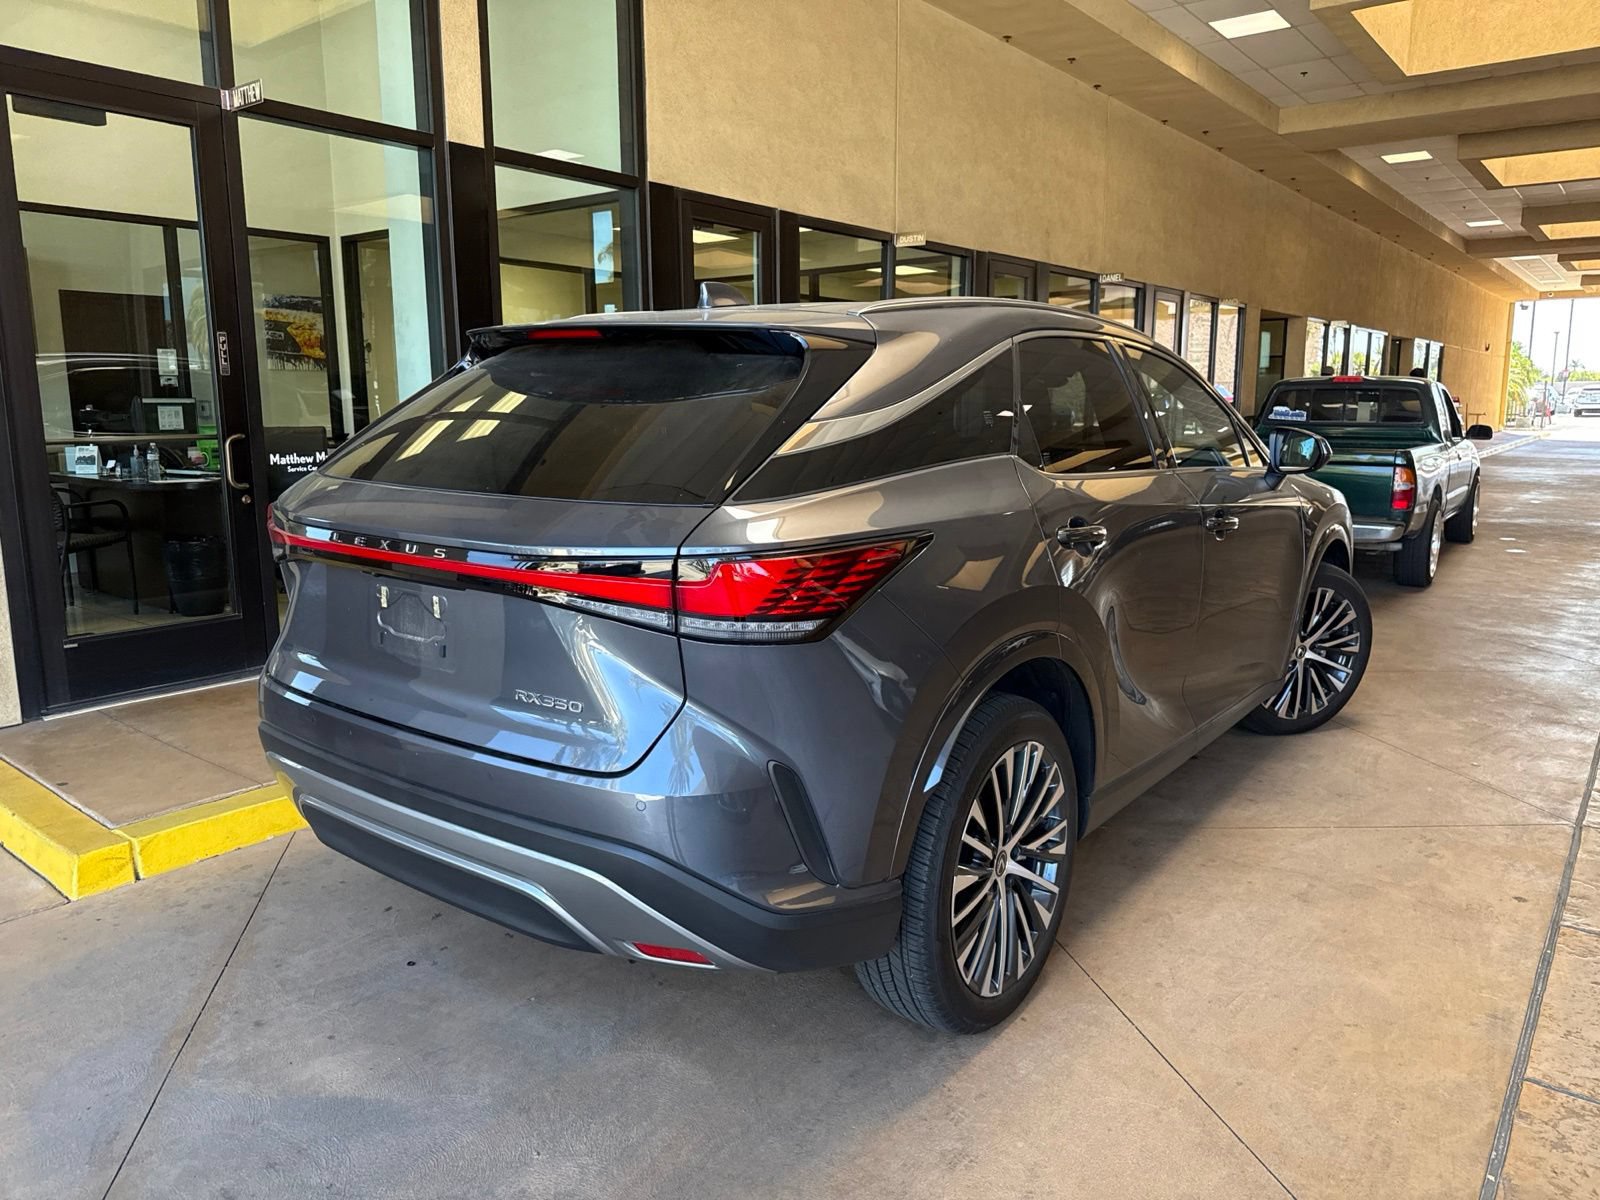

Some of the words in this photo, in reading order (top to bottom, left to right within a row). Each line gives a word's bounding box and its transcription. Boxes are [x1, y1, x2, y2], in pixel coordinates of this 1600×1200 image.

[233, 81, 260, 108] MATTHEW
[899, 234, 924, 244] DUSTIN
[1102, 273, 1123, 283] DANIEL
[219, 336, 228, 365] PULL
[269, 453, 314, 465] Matthew
[315, 451, 328, 463] M
[332, 532, 448, 559] LEXUS
[515, 689, 583, 713] RX350
